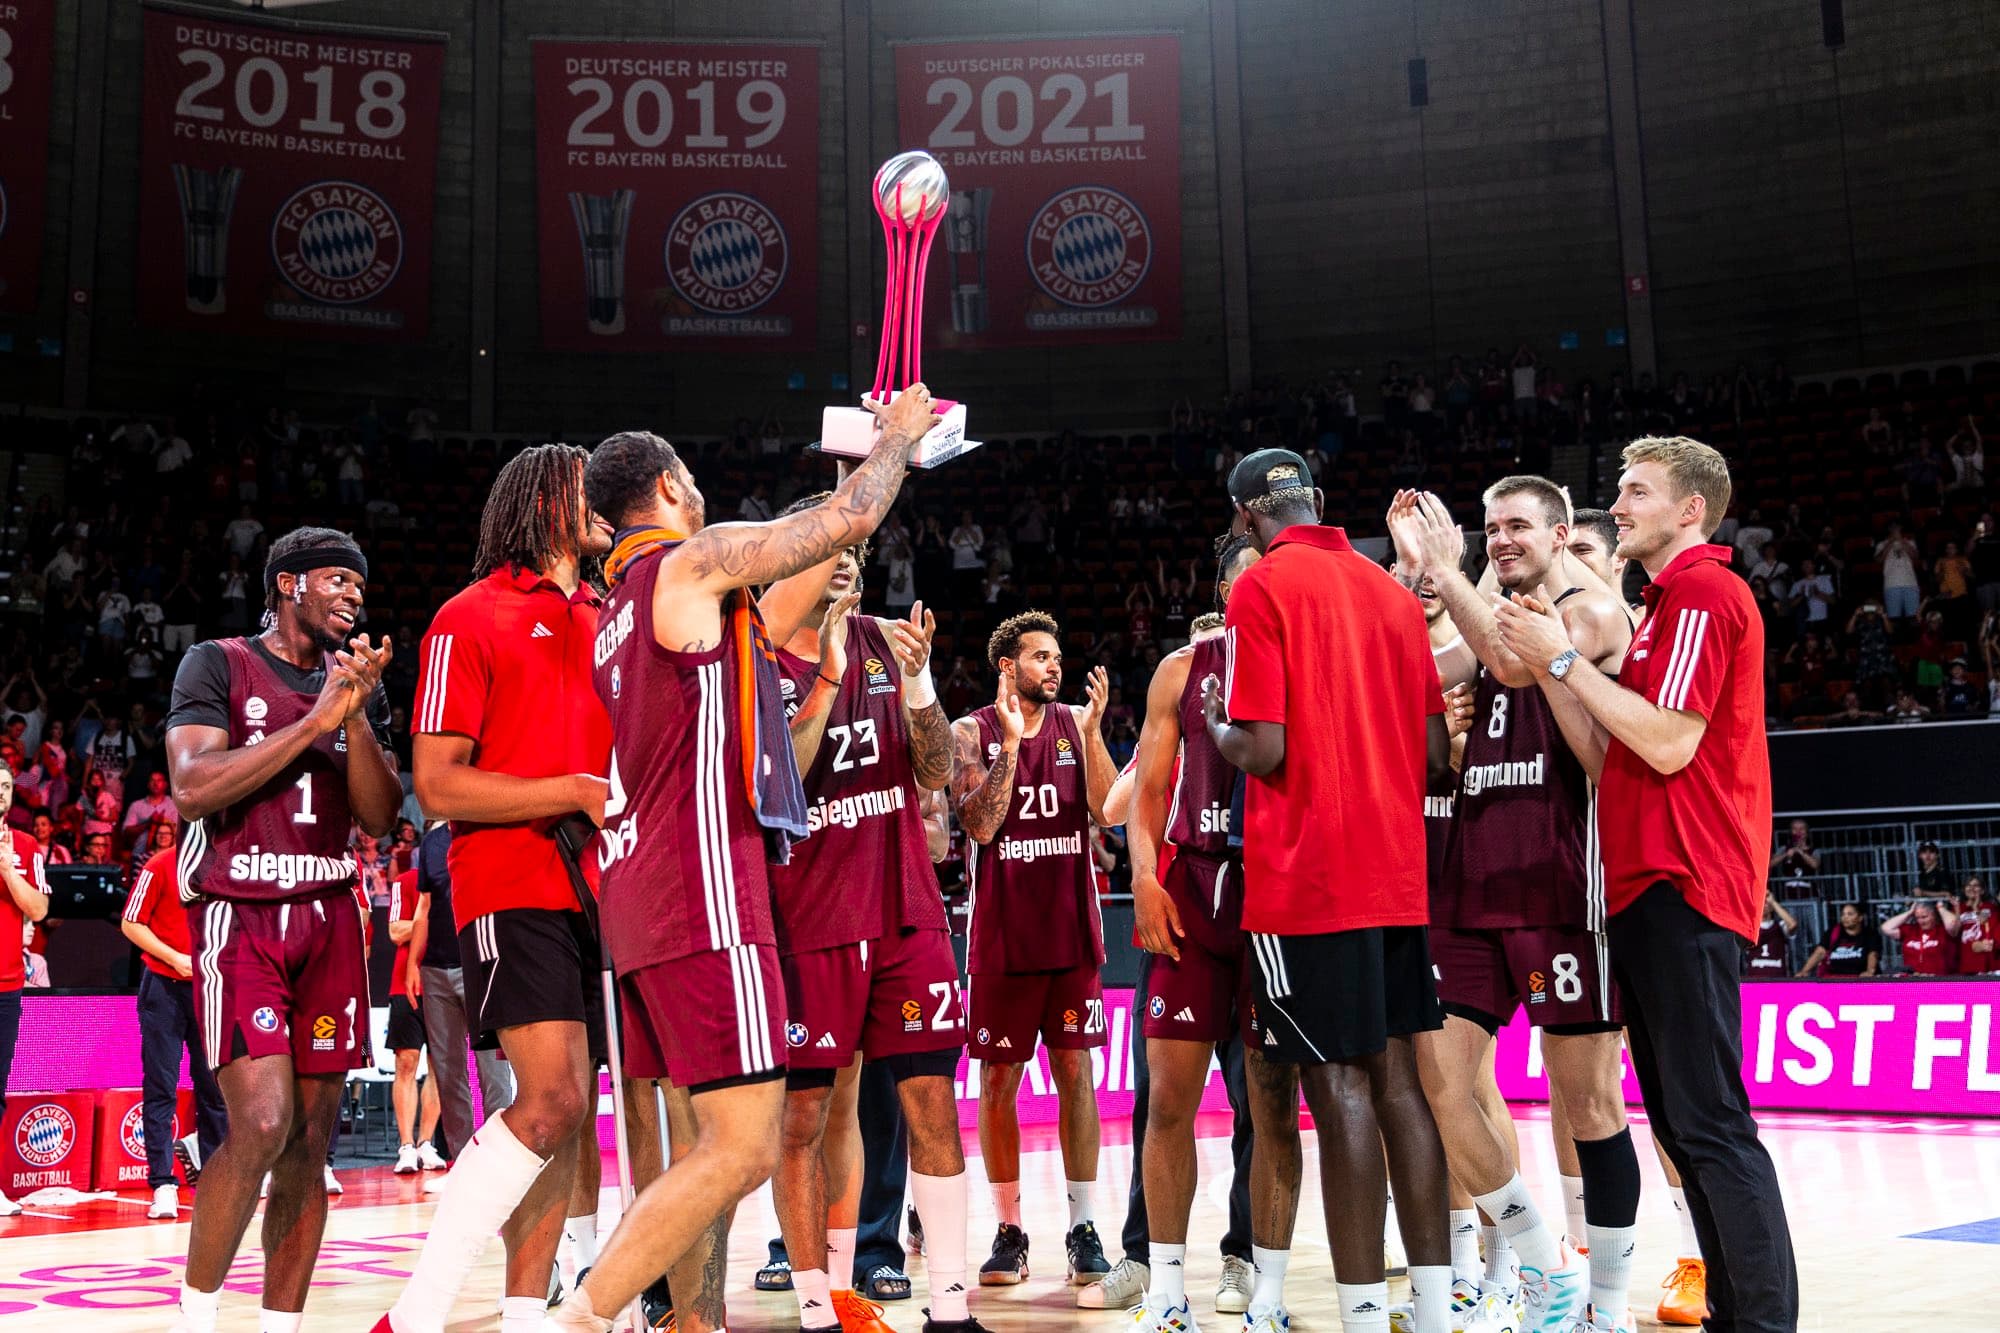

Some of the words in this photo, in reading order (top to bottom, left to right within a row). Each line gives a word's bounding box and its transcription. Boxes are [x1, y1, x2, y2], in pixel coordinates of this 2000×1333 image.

[176, 26, 309, 59] DEUTSCHER
[317, 46, 412, 69] MEISTER
[925, 57, 1024, 74] DEUTSCHER
[1029, 53, 1145, 70] POKALSIEGER
[565, 58, 690, 77] DEUTSCHER
[698, 61, 787, 78] MEISTER
[175, 48, 406, 140] 2018
[567, 77, 786, 149] 2019
[926, 72, 1145, 148] 2021
[174, 122, 196, 138] FC
[203, 126, 278, 149] BAYERN
[285, 136, 406, 160] BASKETBALL
[568, 152, 589, 166] FC
[595, 152, 666, 167] BAYERN
[672, 153, 787, 168] BASKETBALL
[934, 150, 949, 166] C
[954, 149, 1024, 166] BAYERN
[1030, 145, 1146, 163] BASKETBALL
[282, 205, 309, 232] FC
[312, 187, 394, 240] BAYERN
[674, 217, 698, 246] FC
[699, 200, 779, 248] BAYERN
[1035, 211, 1060, 242] FC
[1060, 193, 1142, 239] BAYERN
[670, 317, 785, 332] BASKETBALL
[1034, 309, 1150, 327] BASKETBALL
[1488, 694, 1508, 738] 8
[828, 719, 880, 773] 23
[294, 772, 317, 824] 1
[1018, 784, 1059, 820] 20
[998, 830, 1082, 863] siegmund
[1552, 953, 1582, 1002] 8
[1084, 999, 1104, 1033] 20
[1755, 1002, 1895, 1087] IST
[1911, 1003, 2000, 1092] FL
[20, 1116, 34, 1132] FC
[34, 1107, 72, 1130] BAYERN
[13, 1170, 72, 1188] BASKETBALL
[1500, 1206, 1526, 1220] adidas
